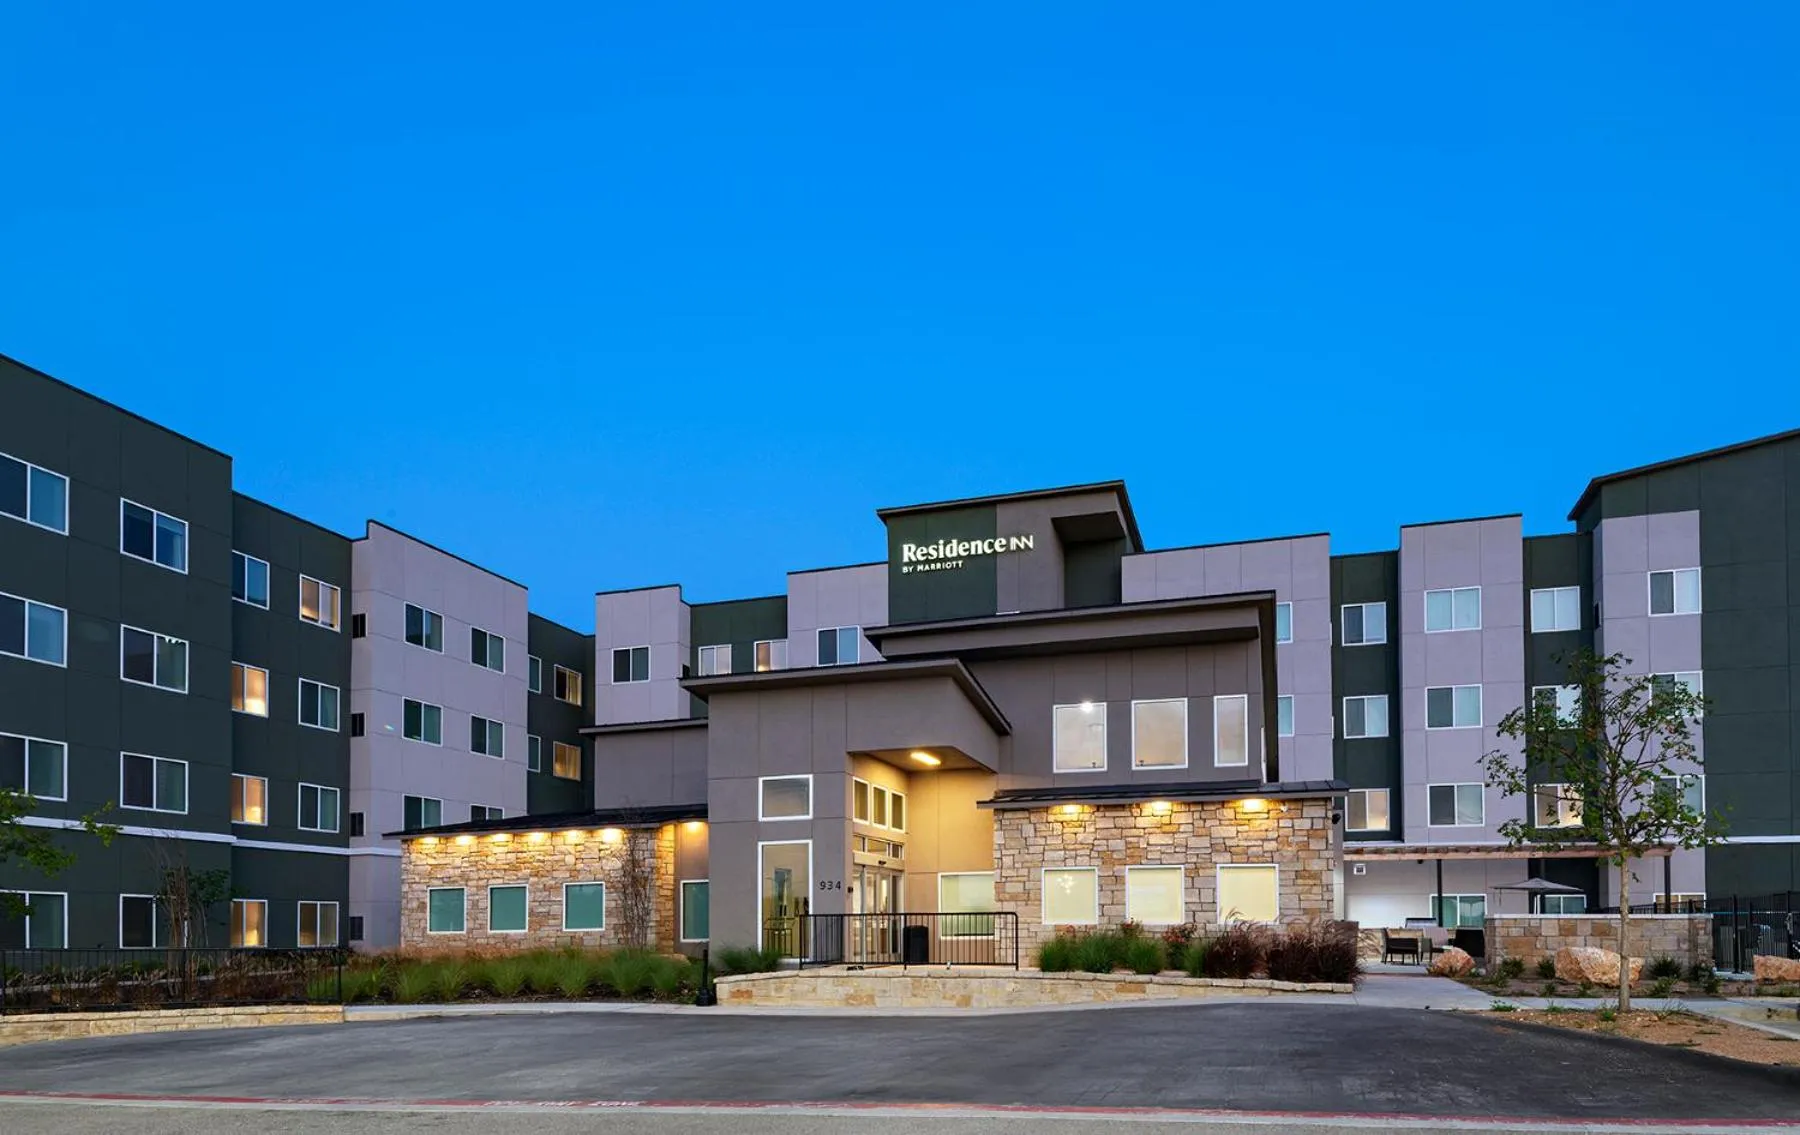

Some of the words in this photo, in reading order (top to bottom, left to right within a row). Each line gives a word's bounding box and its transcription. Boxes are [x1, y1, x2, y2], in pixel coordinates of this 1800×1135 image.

[902, 537, 1006, 562] Residence
[1010, 534, 1034, 550] INN
[917, 560, 963, 572] MARRIOTT
[820, 880, 841, 890] 934
